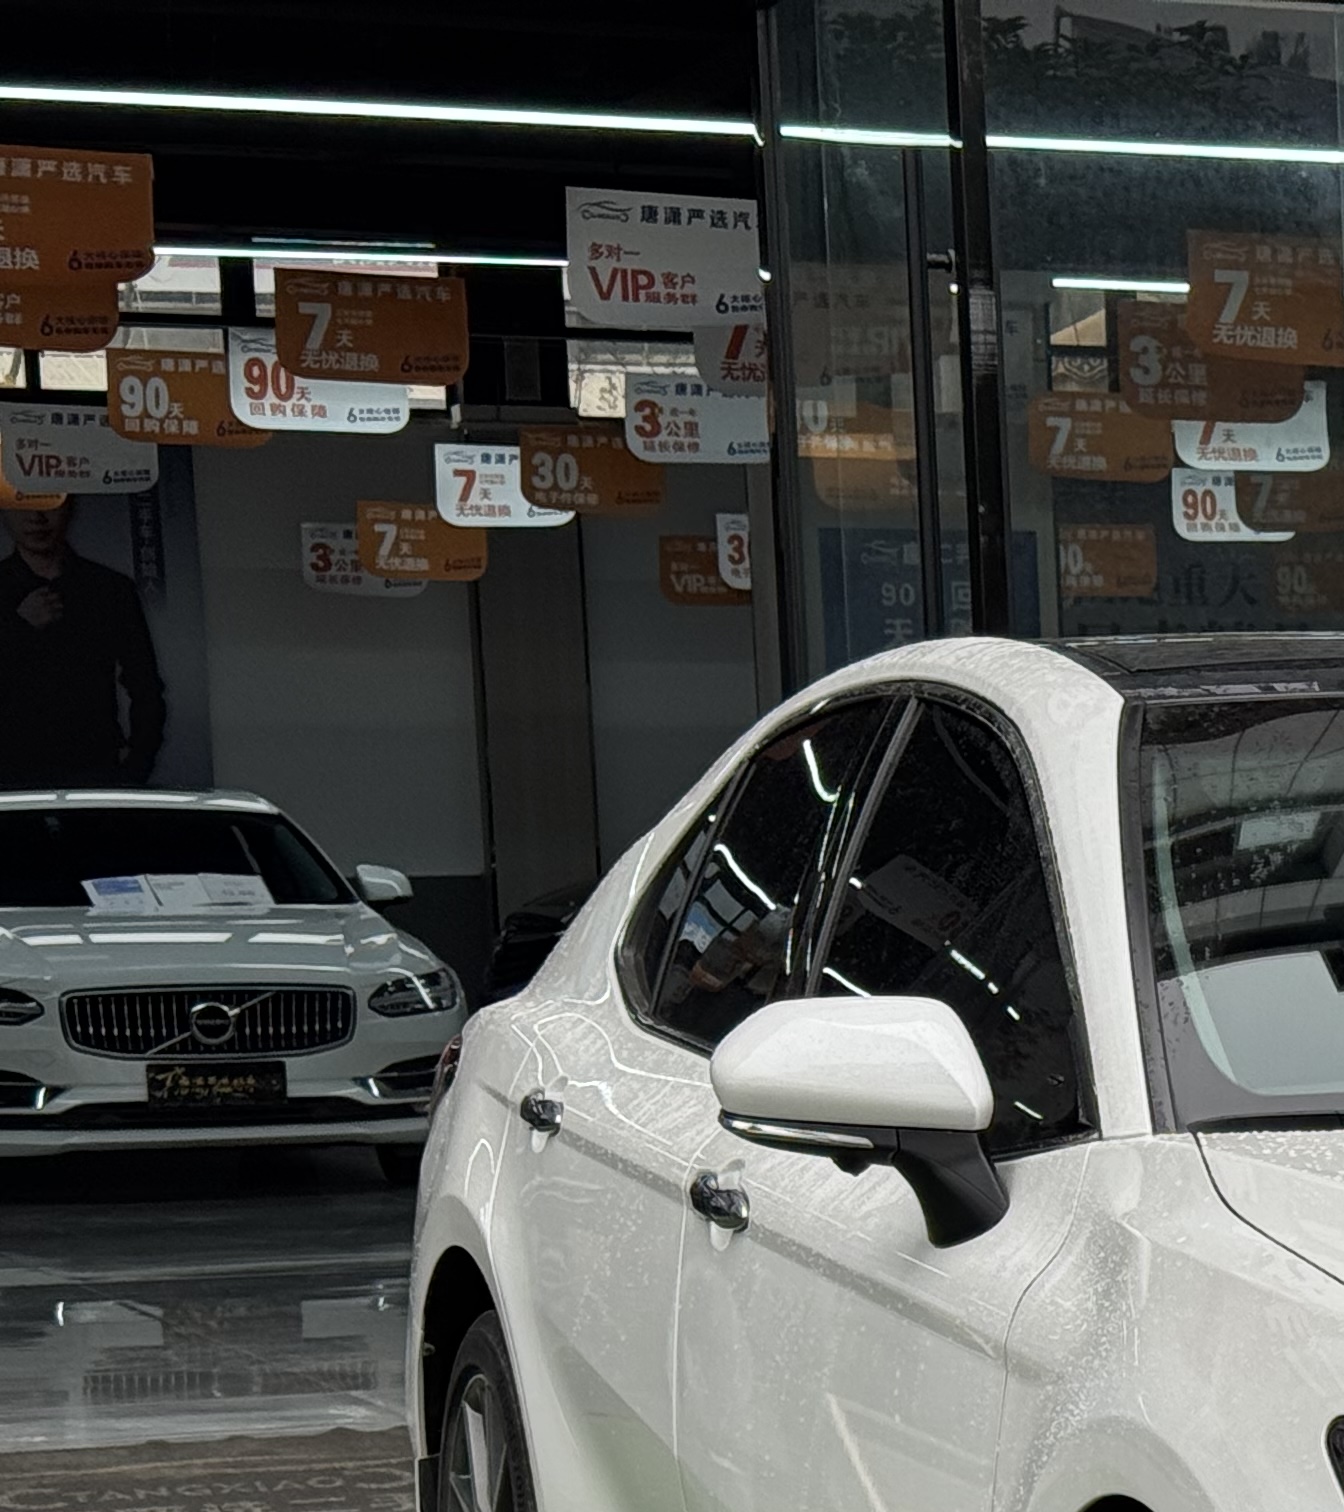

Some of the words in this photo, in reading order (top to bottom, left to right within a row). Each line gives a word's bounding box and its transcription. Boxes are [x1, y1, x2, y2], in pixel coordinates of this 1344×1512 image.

[0, 157, 133, 185] 潇严选汽车
[640, 204, 760, 230] 唐潇严选汽
[588, 242, 640, 262] 多对一
[588, 266, 655, 303] VIP
[661, 272, 696, 290] 客户
[715, 293, 729, 314] 6
[1213, 269, 1249, 323] 7
[1252, 302, 1272, 321] 天
[298, 302, 332, 351] 7
[1212, 324, 1298, 349] 无忧退换
[300, 351, 380, 373] 无忧退换
[1166, 362, 1207, 386] 公里
[250, 402, 327, 418] 回购保障
[124, 420, 199, 436] 回购保障
[666, 421, 699, 437] 公里
[1045, 416, 1072, 458] 7
[15, 453, 61, 477] VIP
[453, 469, 476, 503] 7
[374, 523, 397, 560] 7
[670, 574, 705, 593] VIP
